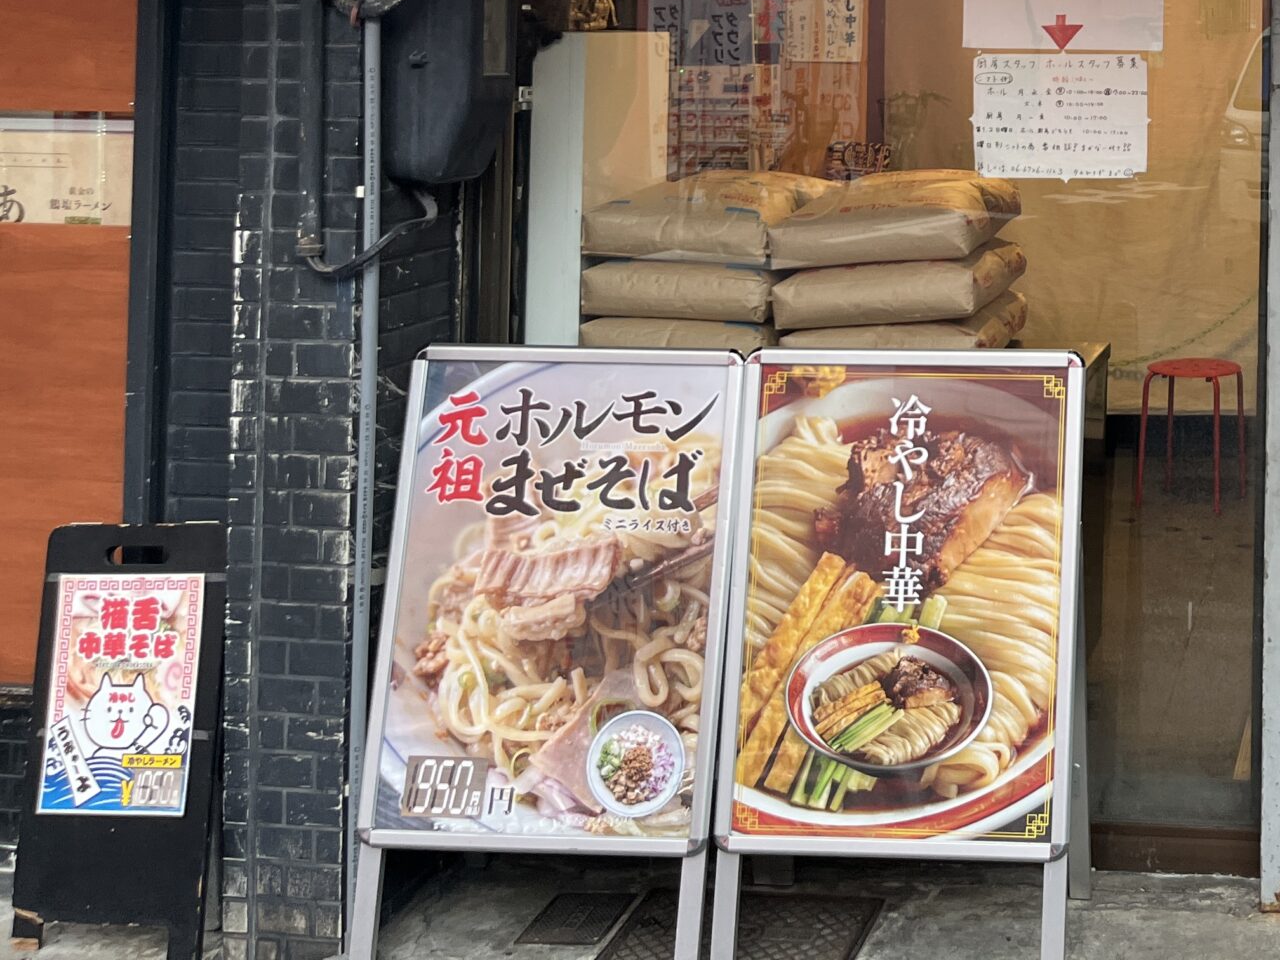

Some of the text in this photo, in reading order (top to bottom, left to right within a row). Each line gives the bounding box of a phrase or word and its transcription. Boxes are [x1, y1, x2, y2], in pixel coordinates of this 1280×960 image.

[495, 387, 721, 448] ホルモン
[426, 391, 490, 504] 元祖
[485, 448, 705, 517] まぜそば
[881, 393, 933, 613] 冷やし中華
[602, 518, 691, 532] ミニライス付き
[101, 596, 162, 632] 猫舌
[78, 631, 178, 660] 中華そば
[108, 692, 136, 704] 冷やし
[127, 756, 177, 766] 冷やしラーメン
[413, 758, 475, 815] 950
